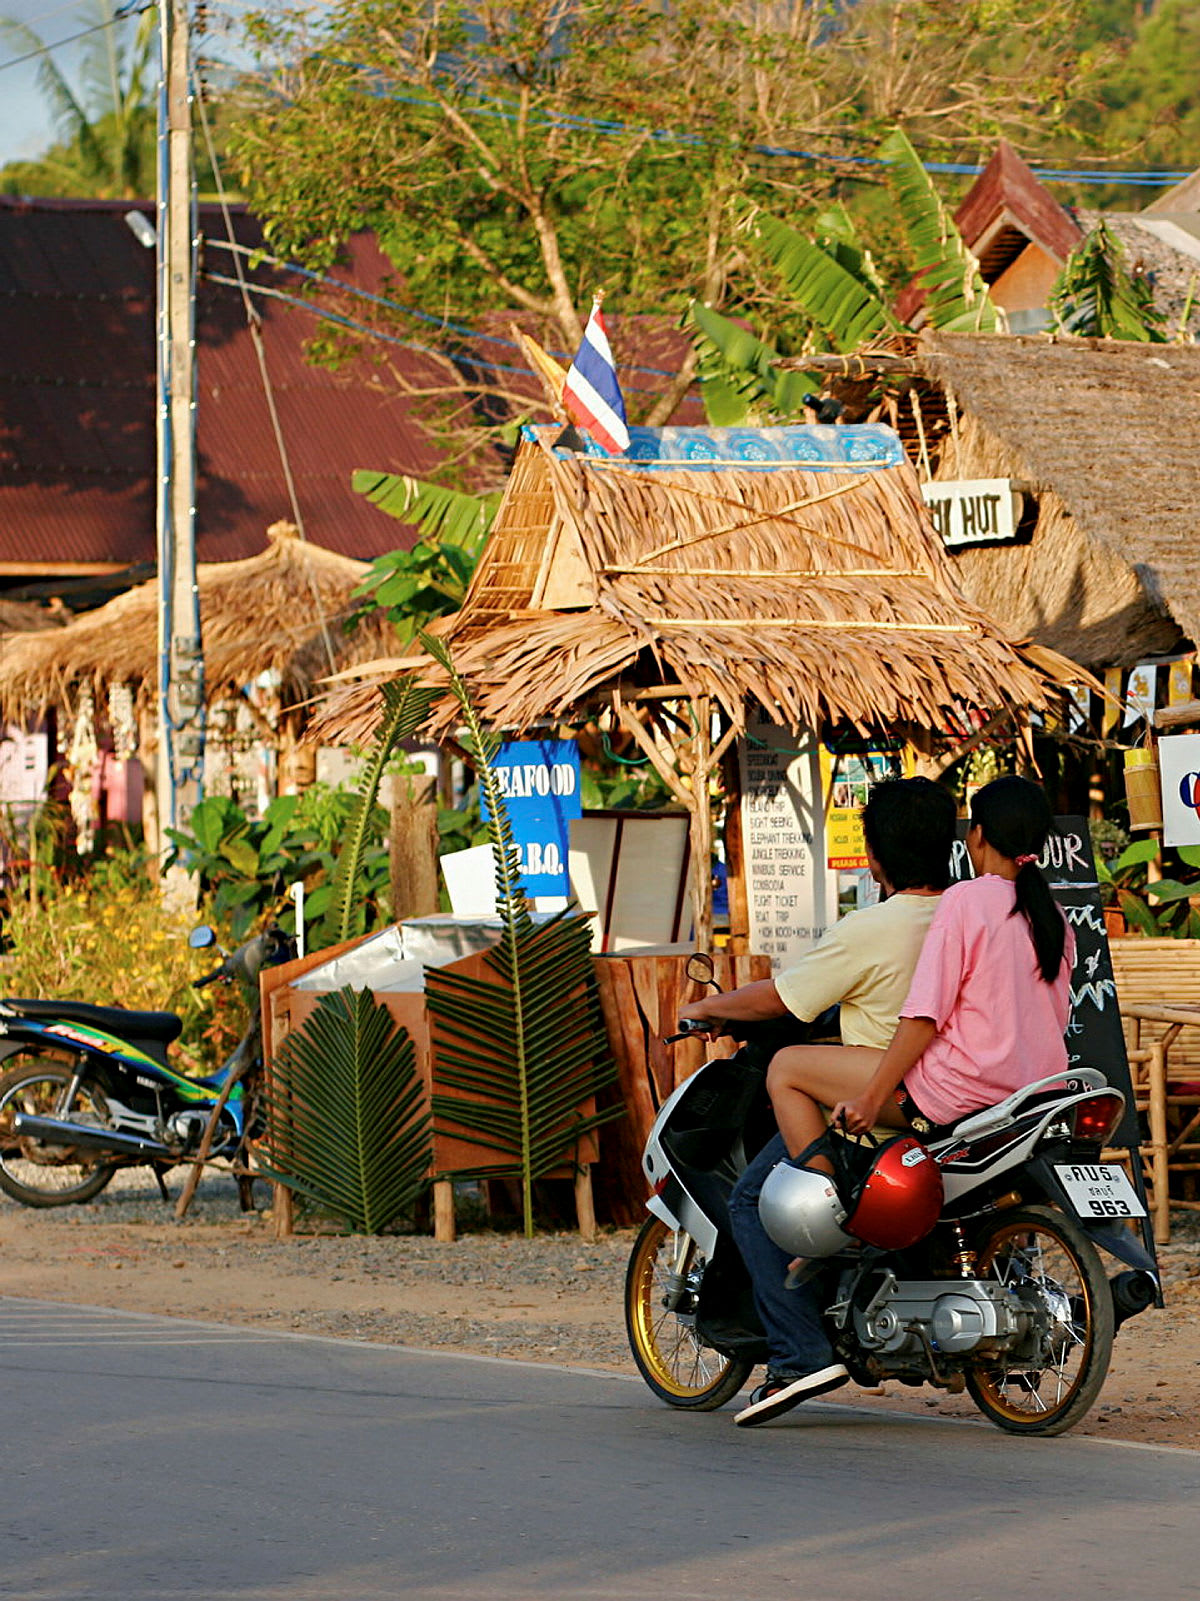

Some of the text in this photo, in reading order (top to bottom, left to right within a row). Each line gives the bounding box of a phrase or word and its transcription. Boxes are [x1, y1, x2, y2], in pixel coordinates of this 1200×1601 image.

[959, 493, 1001, 535] HUT
[750, 832, 813, 845] ELEPHANT TREKKING
[752, 848, 806, 860] JUNGLE TREKKING
[778, 864, 806, 876] SERVICE
[754, 894, 799, 907] FLIGHT TICKET
[755, 910, 790, 922] BOAT TRIP
[1088, 1200, 1131, 1216] 963
